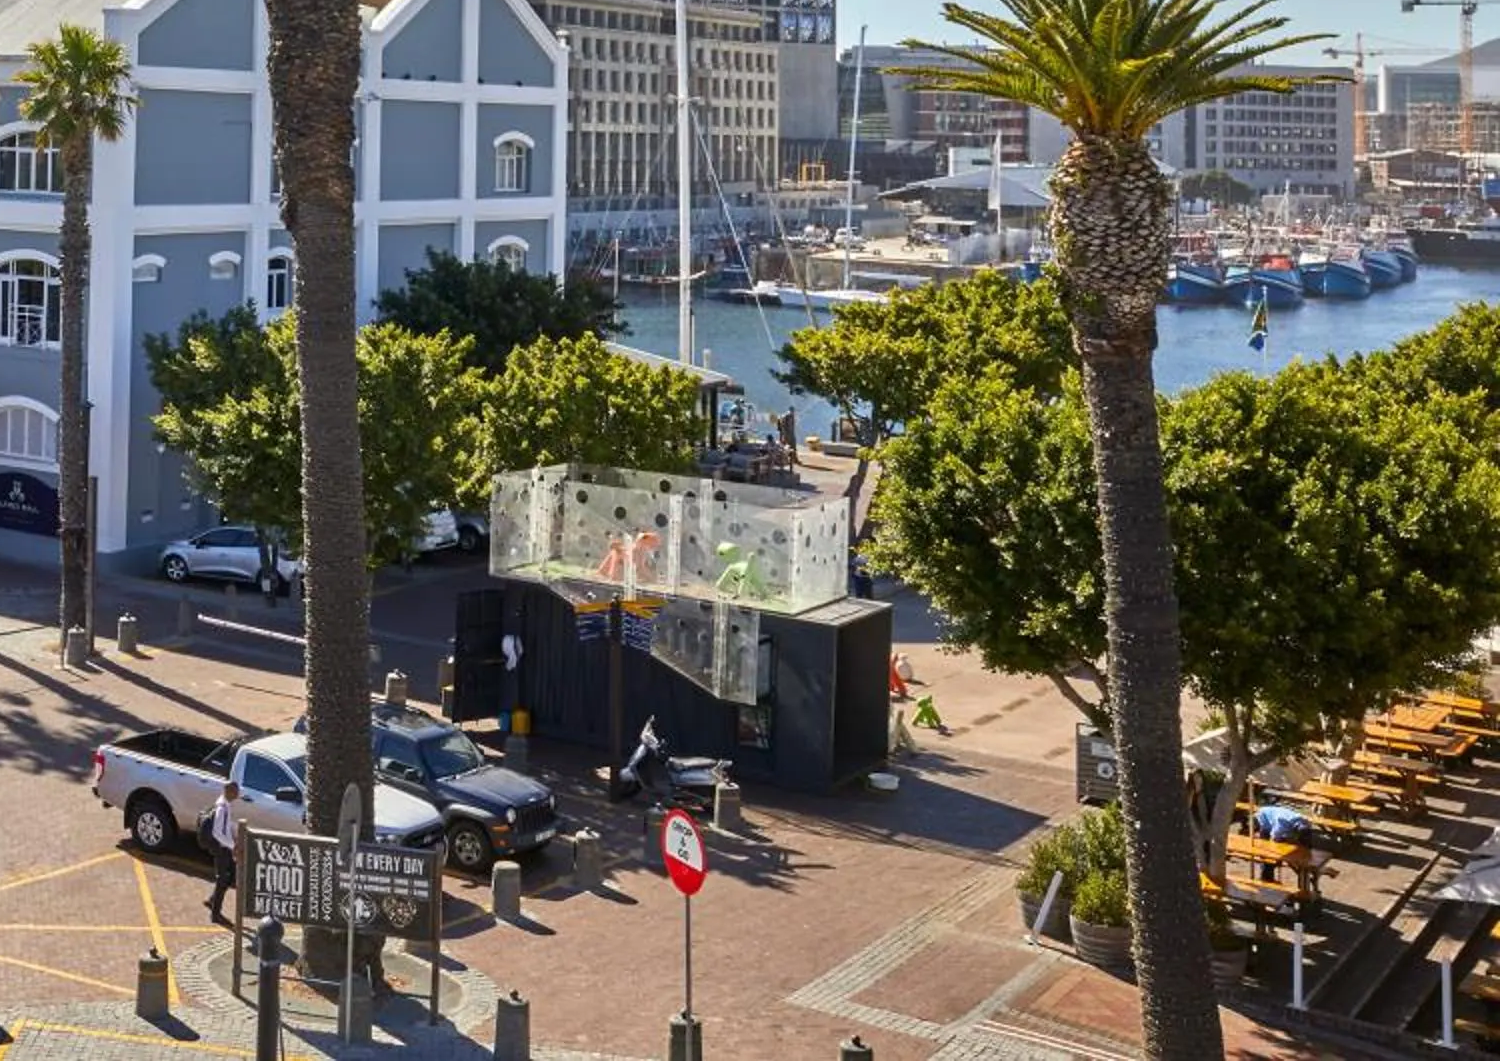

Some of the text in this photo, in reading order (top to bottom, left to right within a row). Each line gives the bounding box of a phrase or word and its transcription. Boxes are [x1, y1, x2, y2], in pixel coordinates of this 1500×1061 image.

[254, 839, 305, 867] V&A
[366, 852, 400, 873] EVERY
[403, 857, 425, 876] DAY
[255, 862, 304, 895] FOOD
